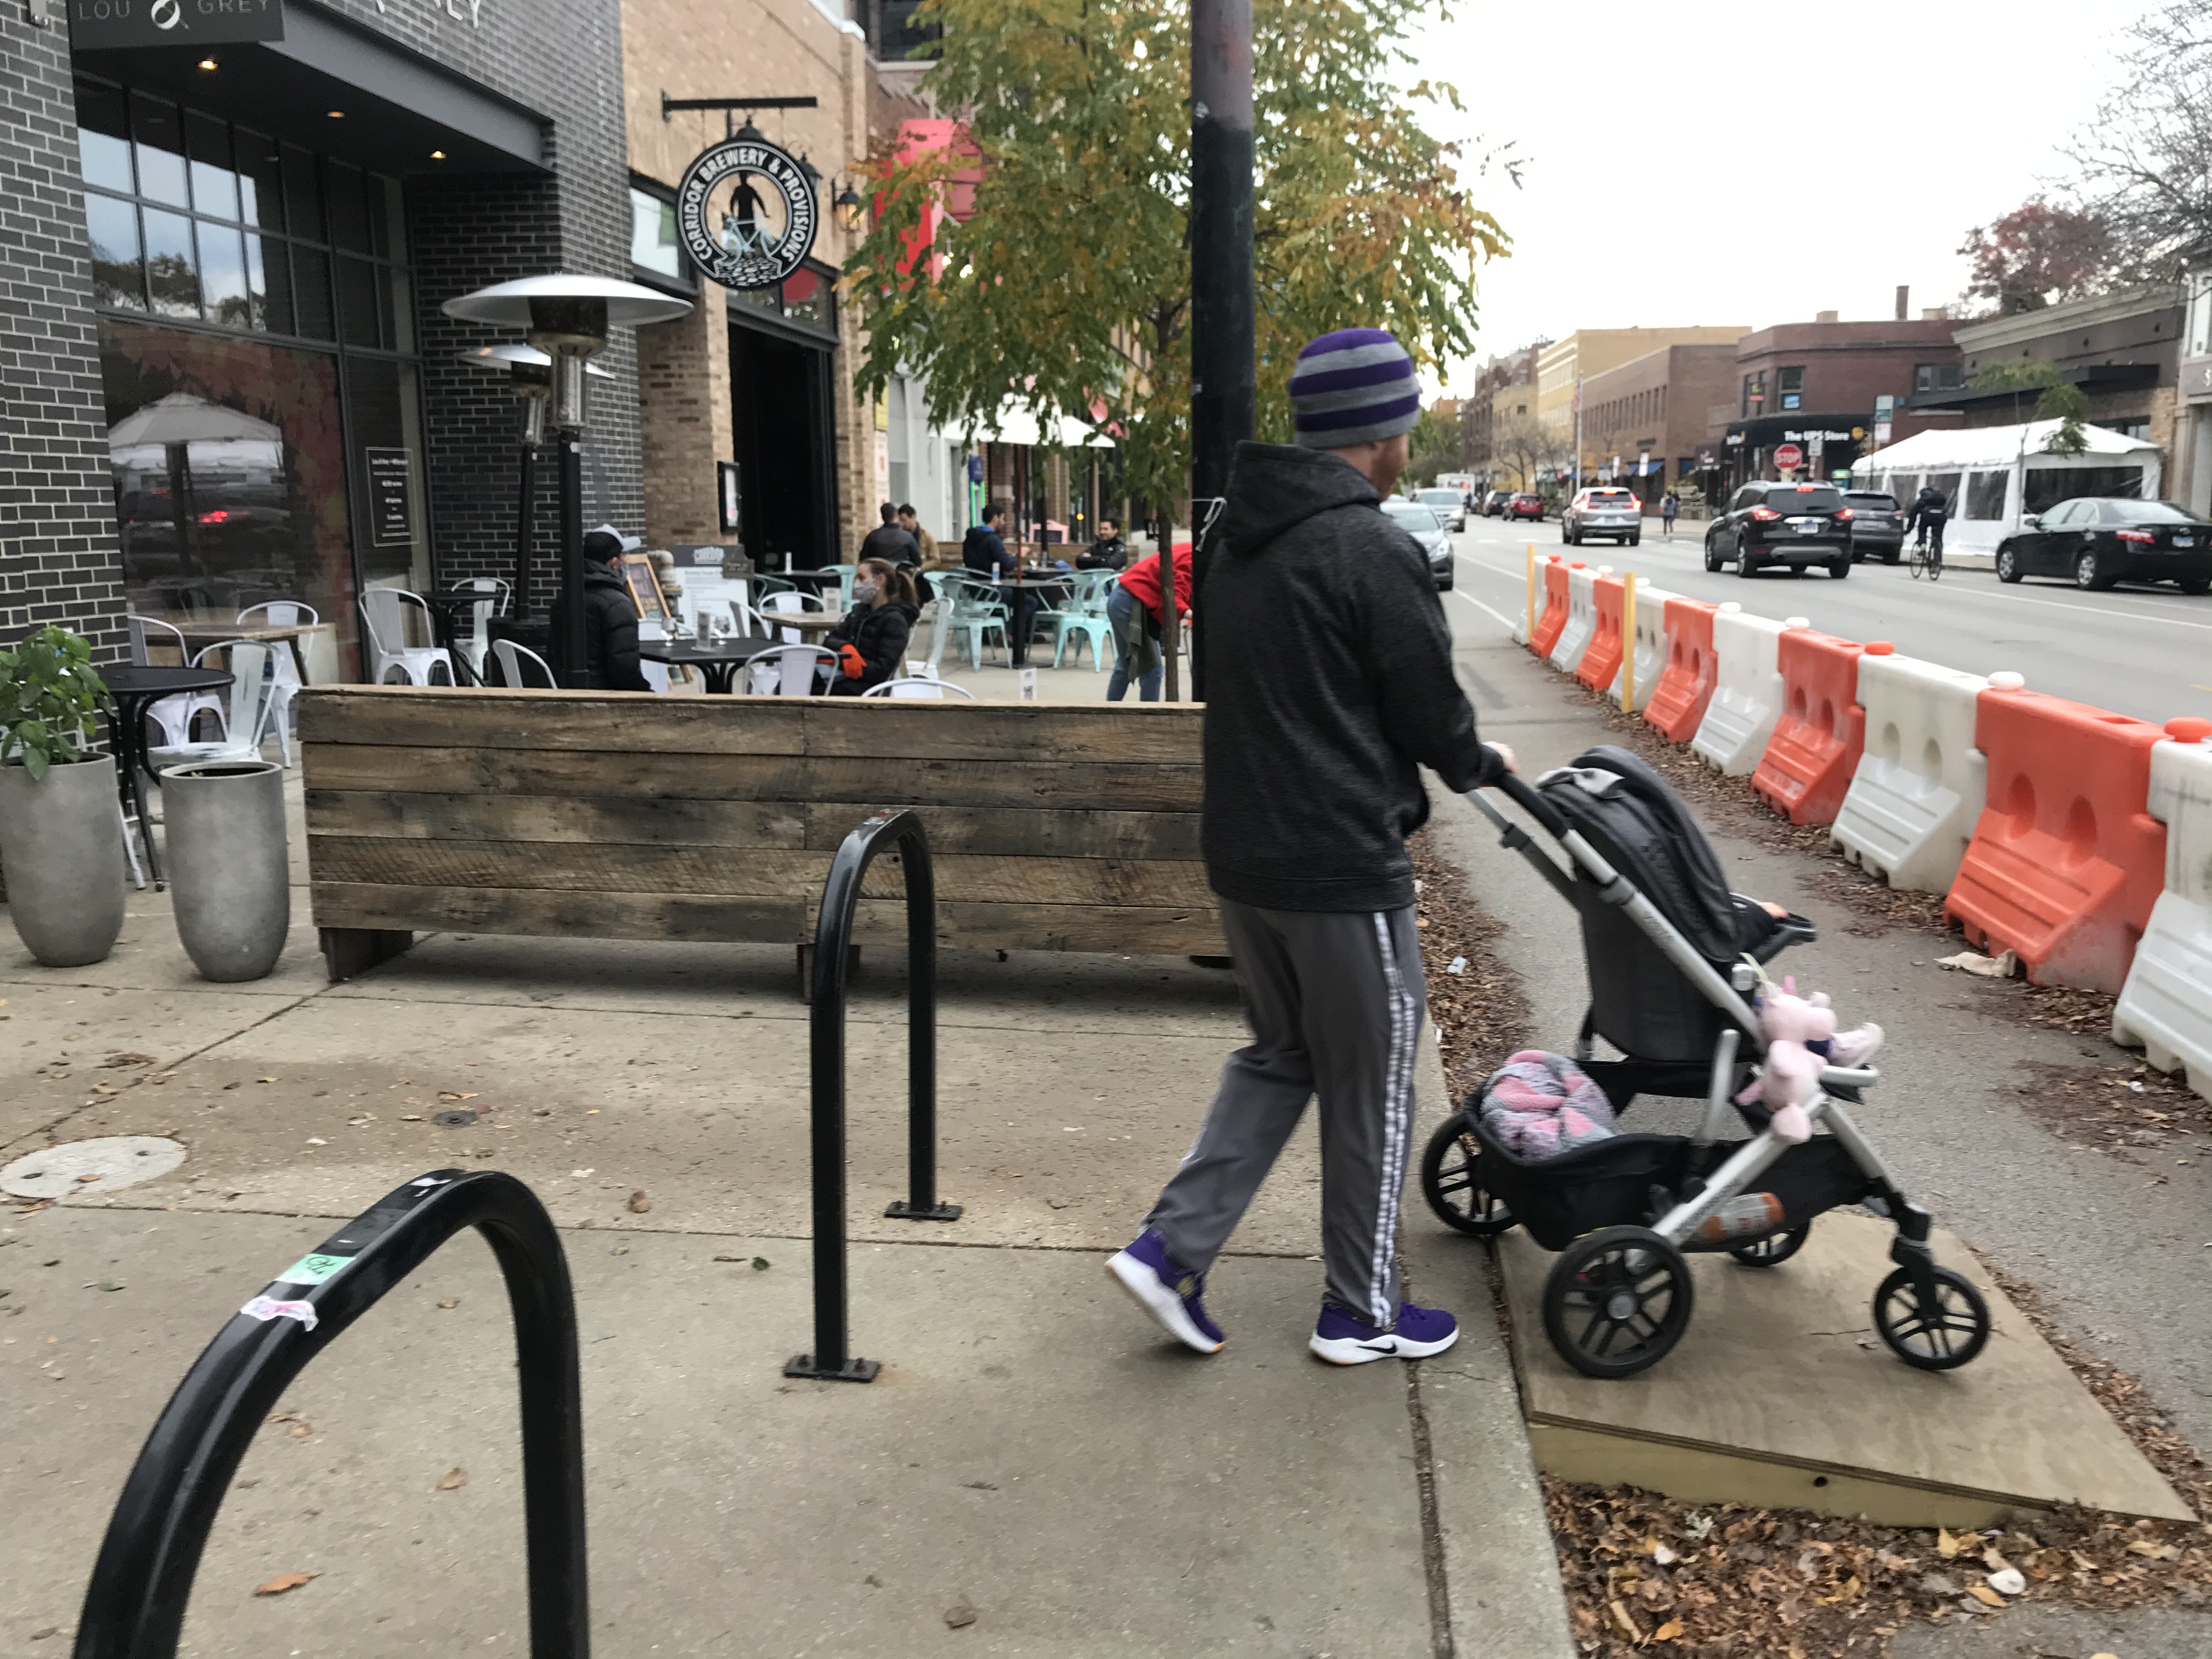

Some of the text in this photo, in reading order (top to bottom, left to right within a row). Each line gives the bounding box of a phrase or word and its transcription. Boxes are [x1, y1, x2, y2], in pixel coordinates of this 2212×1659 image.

[79, 0, 131, 20] LOU
[198, 0, 268, 15] GREY
[684, 148, 809, 262] CORRIDOR BREWERY & PROVISIONS
[1784, 430, 1850, 441] The UPS Store
[1776, 453, 1800, 464] STOP
